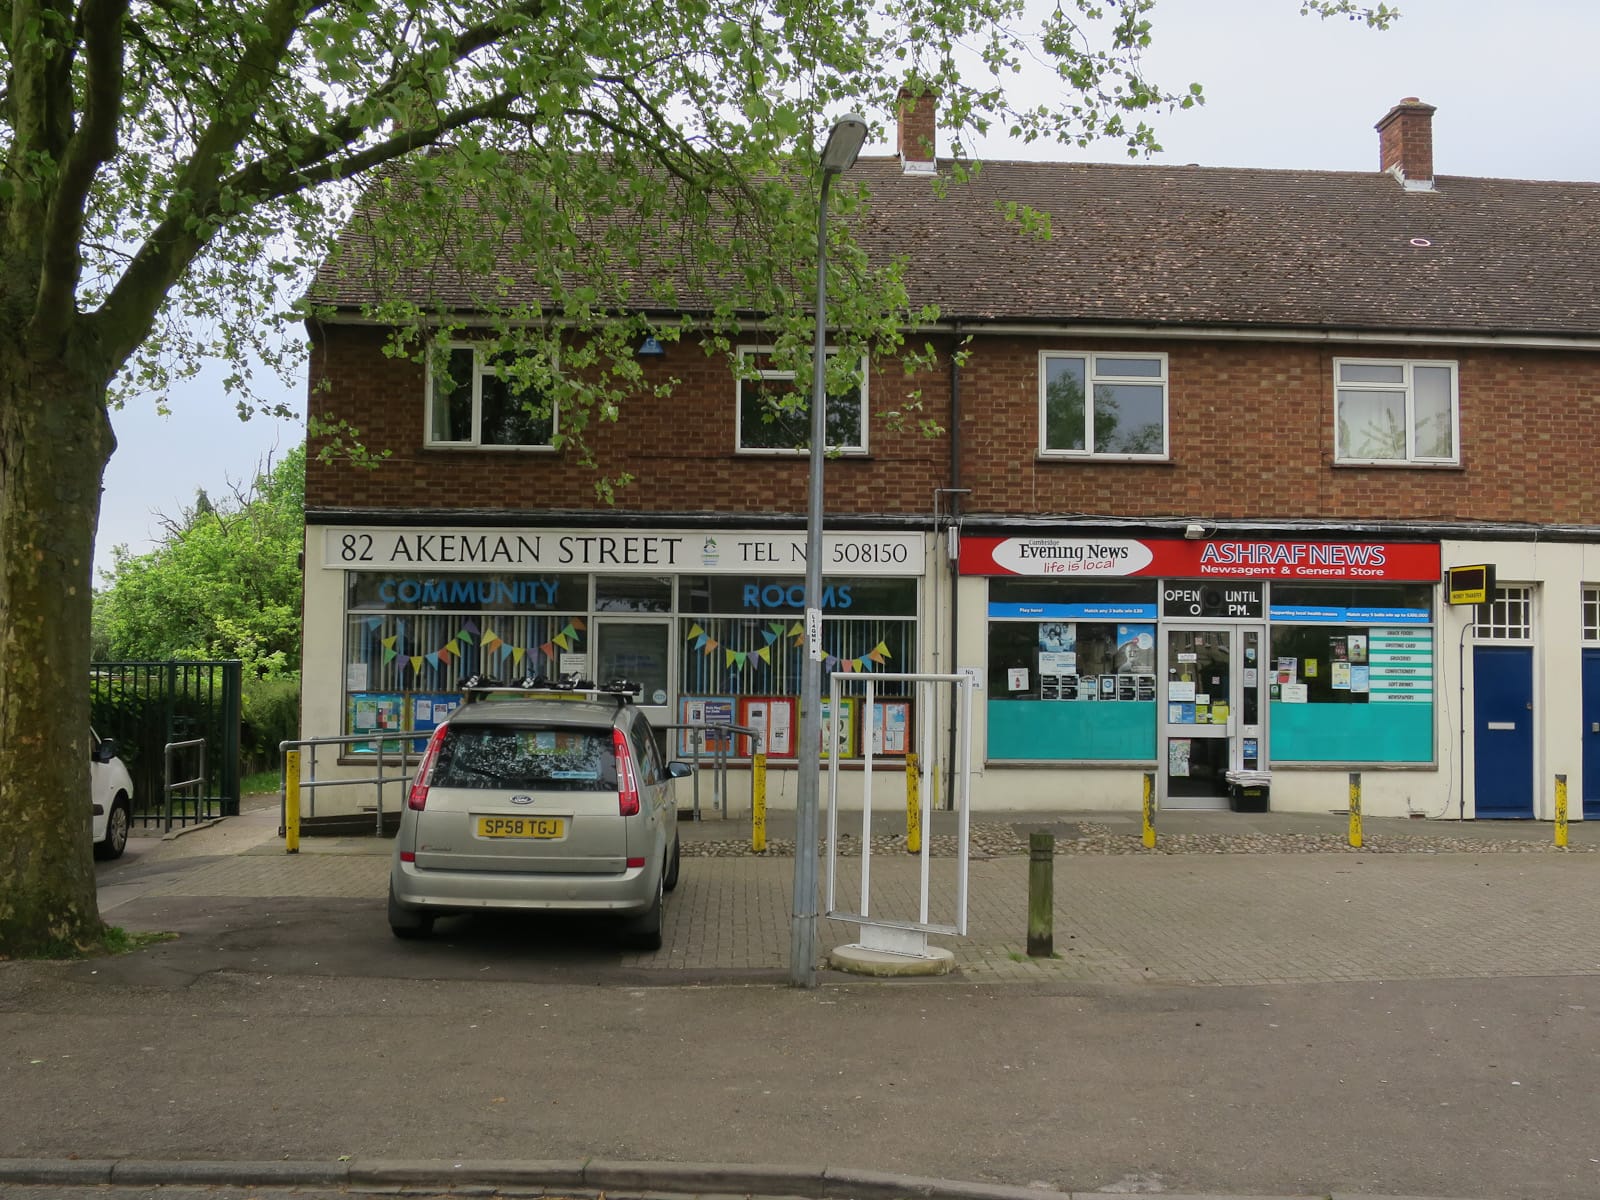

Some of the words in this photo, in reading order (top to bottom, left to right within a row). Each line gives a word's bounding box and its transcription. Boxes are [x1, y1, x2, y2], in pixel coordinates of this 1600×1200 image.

[341, 534, 373, 561] 82
[390, 535, 542, 563] AKEMAN
[558, 536, 683, 564] STREET
[737, 542, 780, 562] TEL
[791, 542, 808, 562] N
[833, 543, 908, 563] 508150
[1019, 543, 1084, 562] Evening
[1087, 544, 1129, 559] News
[1200, 543, 1305, 565] ASHRAF
[1309, 545, 1386, 566] NEWS
[1044, 562, 1065, 573] life
[1068, 561, 1080, 571] is
[1083, 559, 1115, 570] local
[1201, 565, 1275, 576] Newsagent
[1280, 567, 1291, 575] &
[1296, 566, 1345, 575] General
[1350, 567, 1385, 576] Store
[378, 579, 560, 605] COMMUNITY
[1164, 590, 1200, 601] OPEN
[1225, 590, 1259, 603] UNTIL
[485, 819, 524, 834] SP58
[529, 820, 558, 835] TGJ
